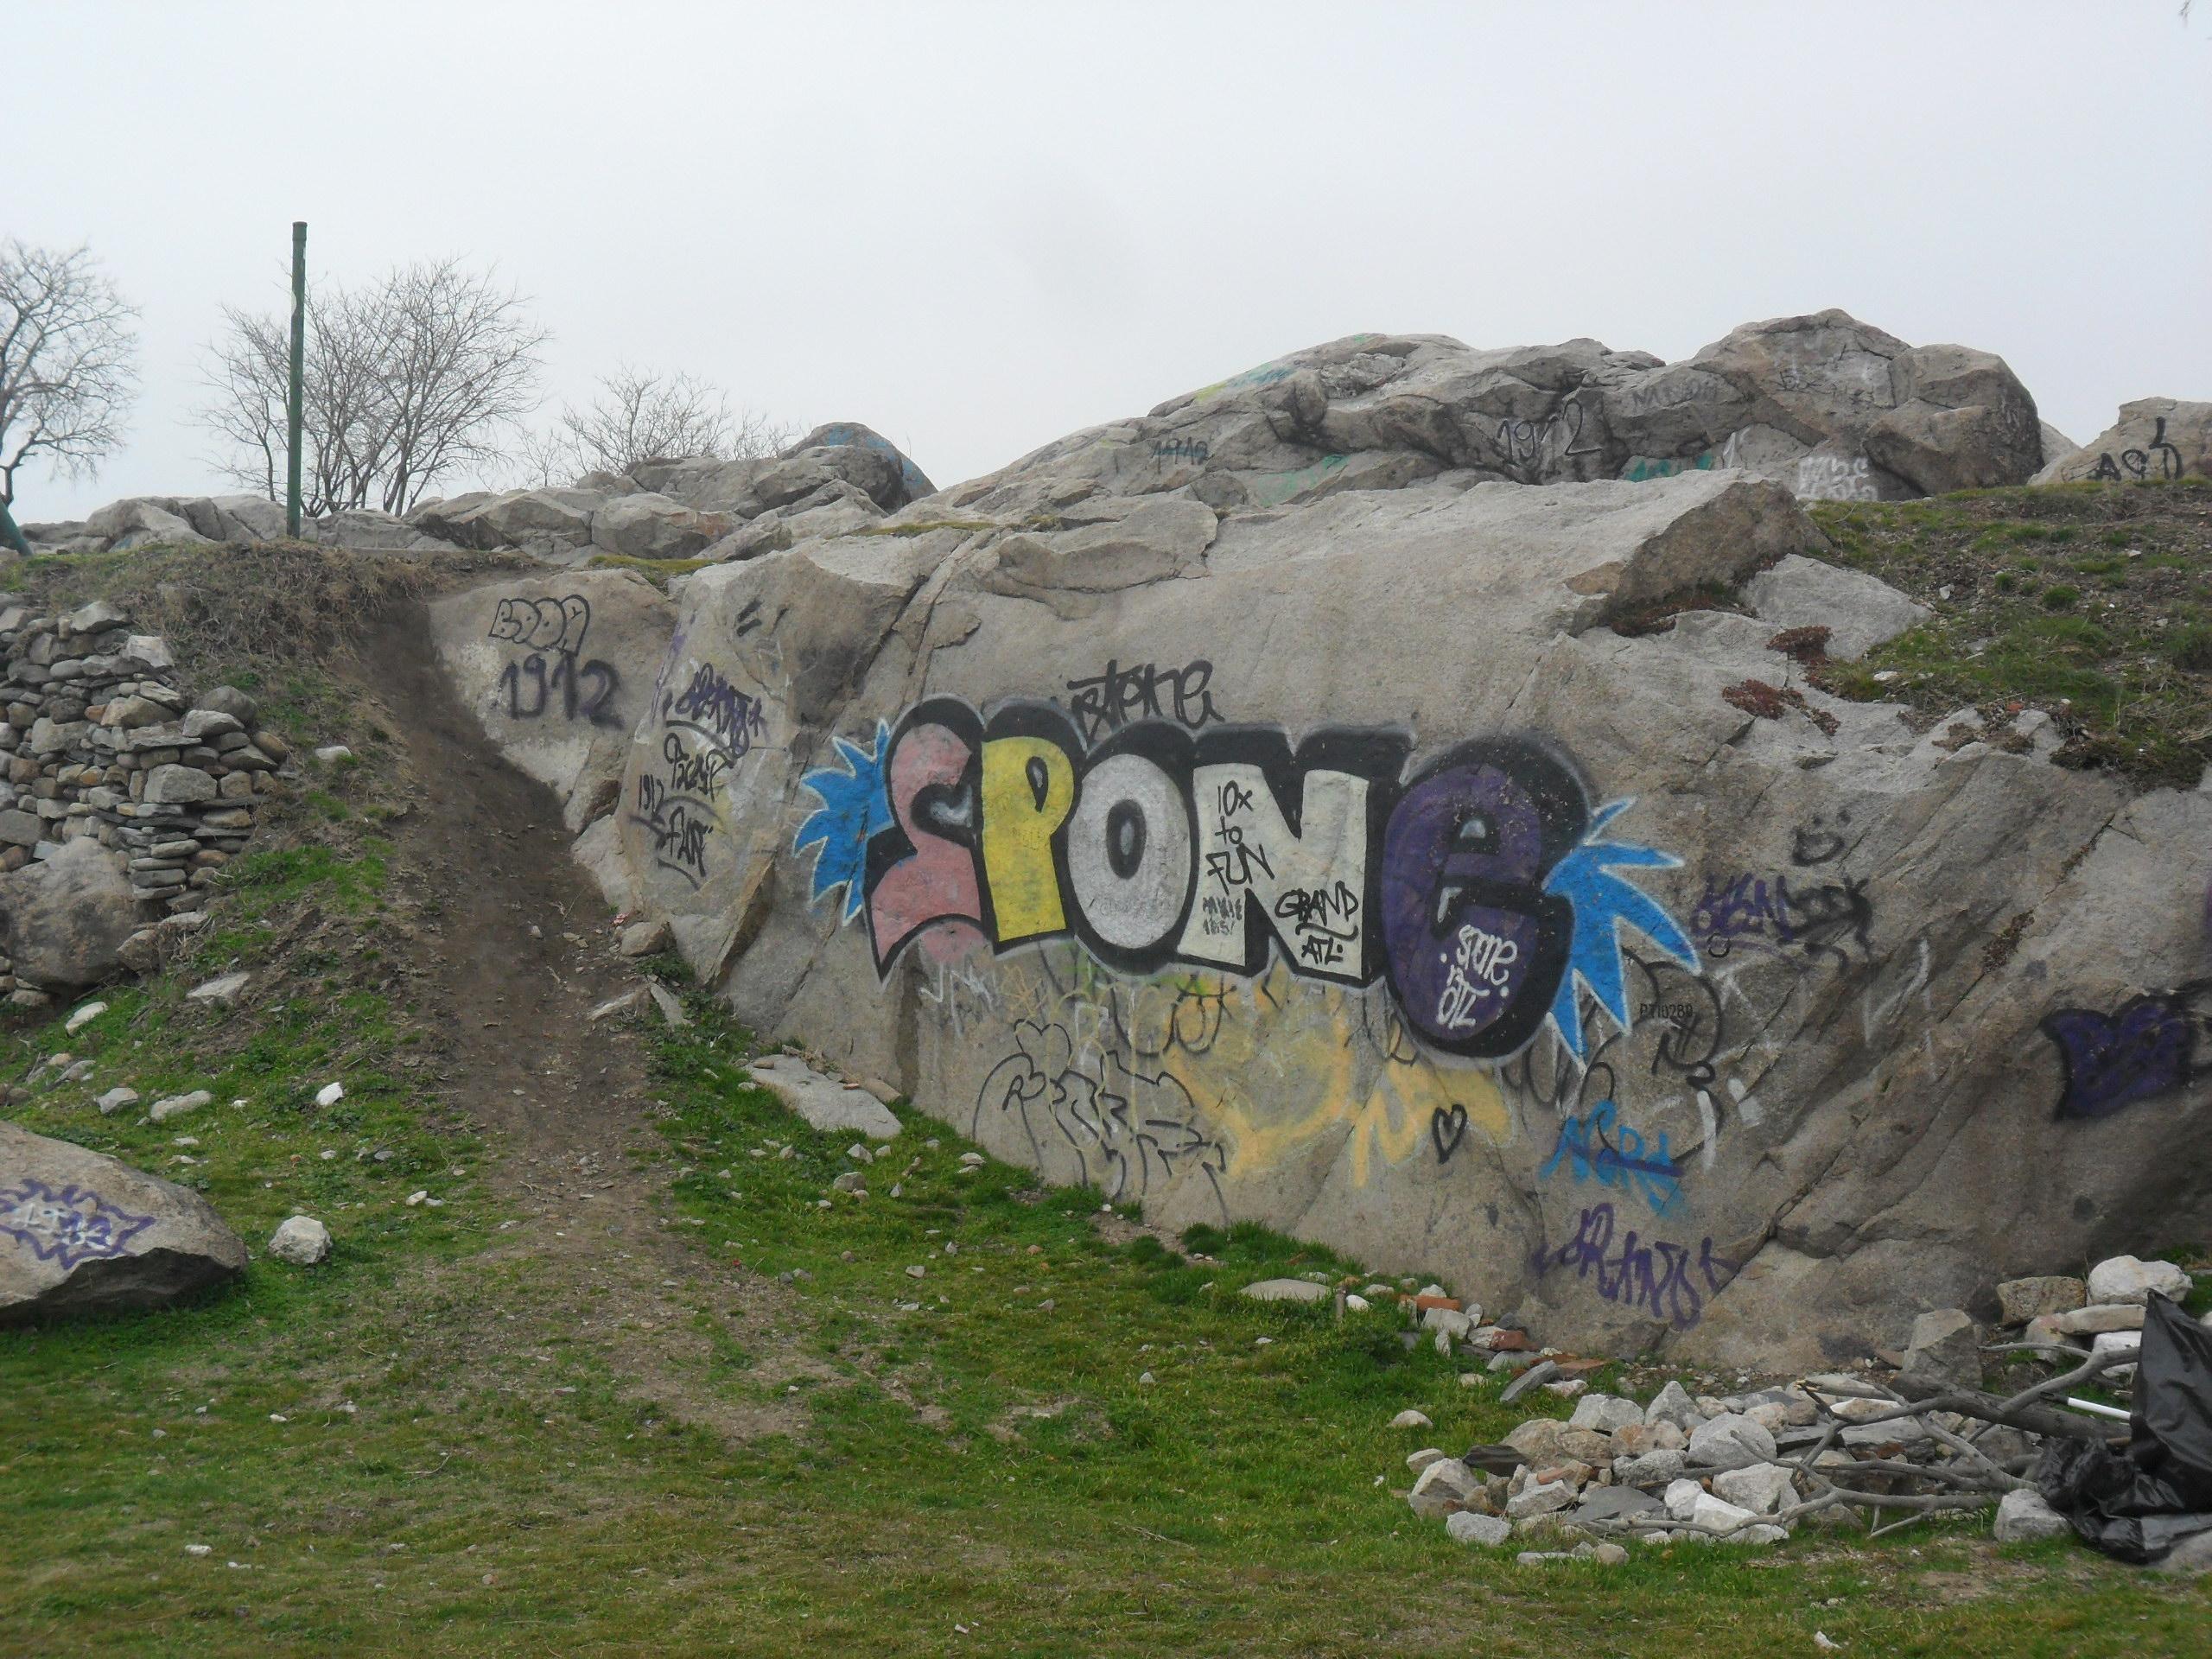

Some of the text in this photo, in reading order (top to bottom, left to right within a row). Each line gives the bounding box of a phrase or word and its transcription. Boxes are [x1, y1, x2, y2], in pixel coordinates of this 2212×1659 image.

[1214, 815, 1243, 844] to
[1205, 842, 1275, 896] FUN
[1274, 880, 1359, 927] GRAND
